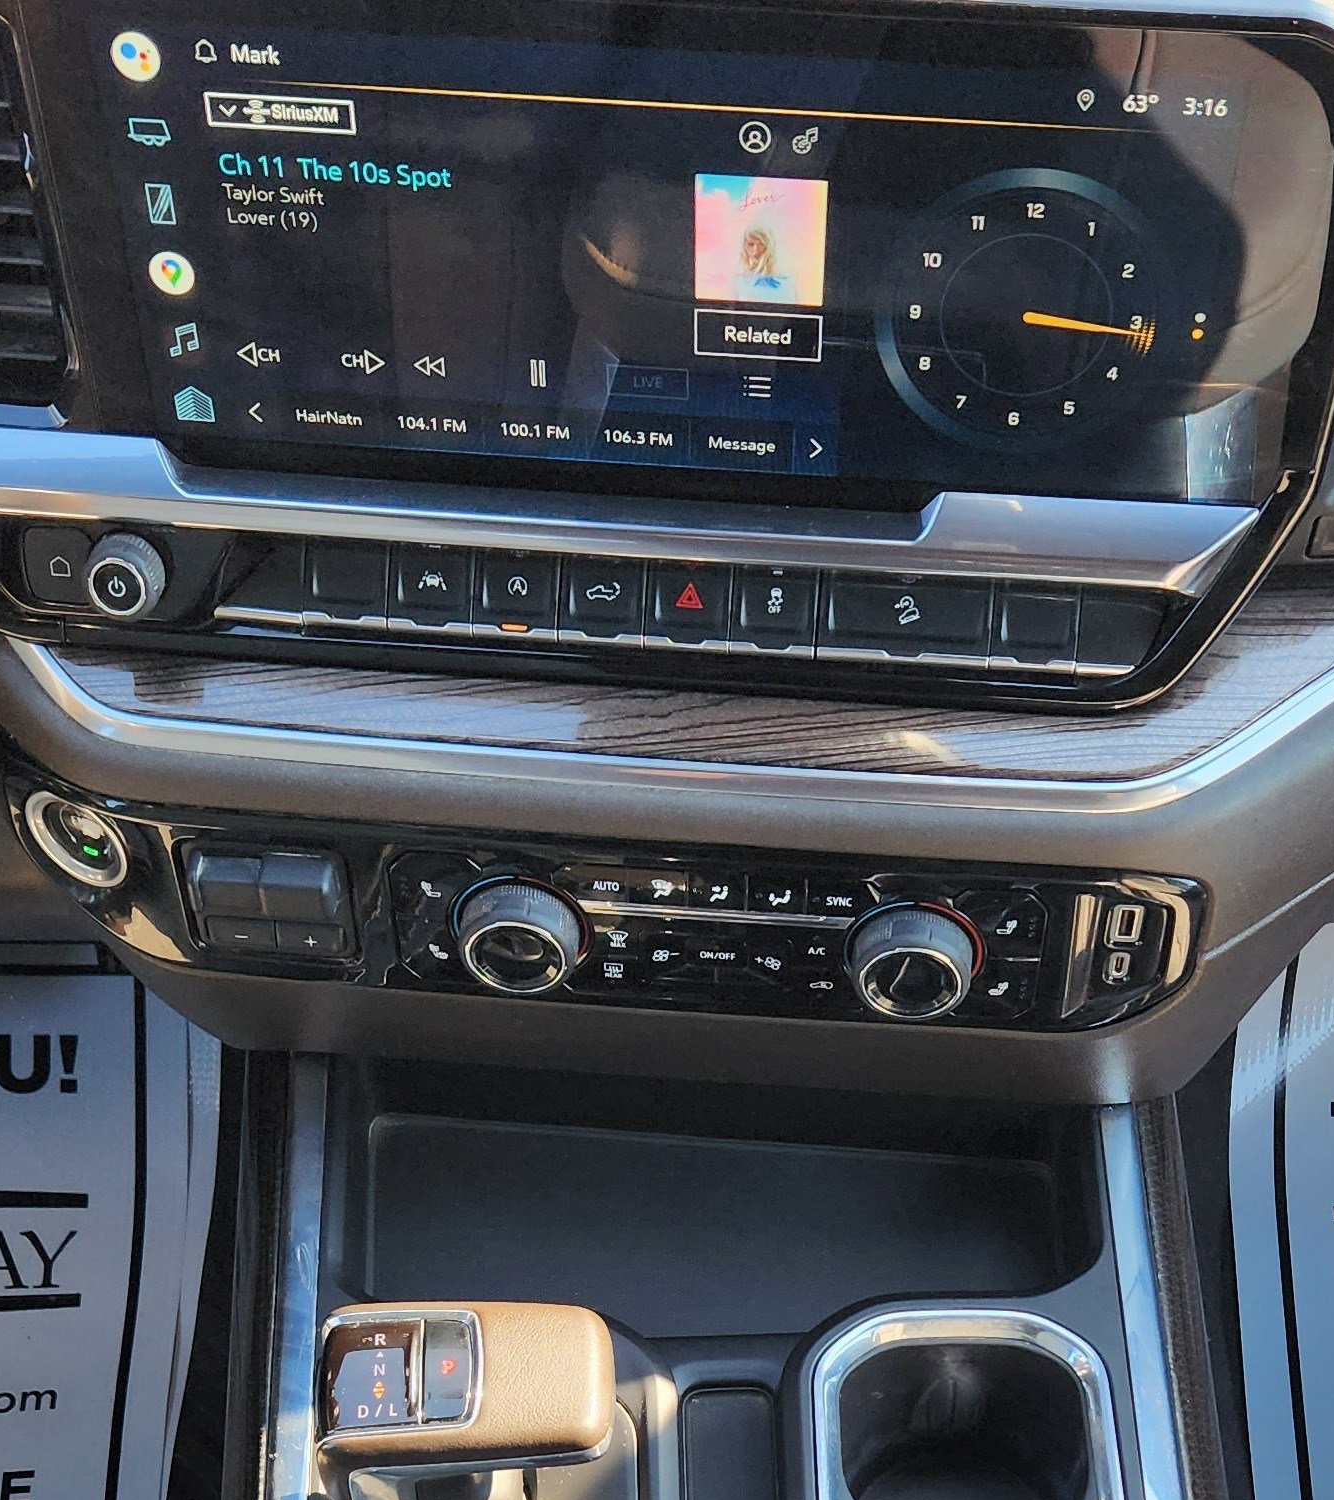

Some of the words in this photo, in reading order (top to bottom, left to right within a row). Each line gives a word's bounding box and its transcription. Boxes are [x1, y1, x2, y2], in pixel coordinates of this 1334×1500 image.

[230, 43, 281, 66] Mark
[270, 103, 340, 124] SiriusXM
[1182, 97, 1228, 117] 3:16
[218, 152, 252, 177] Ch
[258, 155, 285, 178] 11
[296, 157, 343, 183] The
[348, 161, 392, 185] 10s
[396, 164, 453, 192] Spot
[221, 182, 276, 206] Taylor
[279, 186, 325, 207] Swift
[226, 206, 276, 227] Lover
[280, 209, 319, 233] (19)
[1026, 202, 1046, 220] 12
[971, 215, 986, 232] 11
[1087, 221, 1097, 238] 1
[922, 252, 943, 269] 10
[1121, 262, 1136, 280] 2
[909, 304, 923, 320] 9
[1129, 315, 1144, 332] 3
[723, 325, 793, 346] Related
[257, 348, 282, 364] CH
[340, 353, 365, 369] CH
[918, 356, 932, 372] 8
[632, 375, 664, 390] LIVE
[1105, 366, 1120, 382] 4
[955, 394, 968, 410] 7
[1063, 400, 1076, 416] 5
[295, 408, 364, 427] HairNatn
[396, 415, 438, 432] 104.1
[442, 417, 467, 434] FM
[1007, 411, 1020, 427] 6
[500, 422, 541, 439] 100.1
[546, 424, 570, 440] FM
[603, 429, 646, 446] 106.3
[649, 431, 674, 447] FM
[708, 435, 776, 455] Message
[768, 605, 782, 615] OFF
[592, 880, 620, 892] AUTO
[825, 896, 853, 908] SYNC
[699, 951, 736, 961] ON/OFF
[808, 947, 826, 956] A/C
[375, 1334, 386, 1346] R
[374, 1364, 385, 1376] N
[442, 1360, 457, 1374] P
